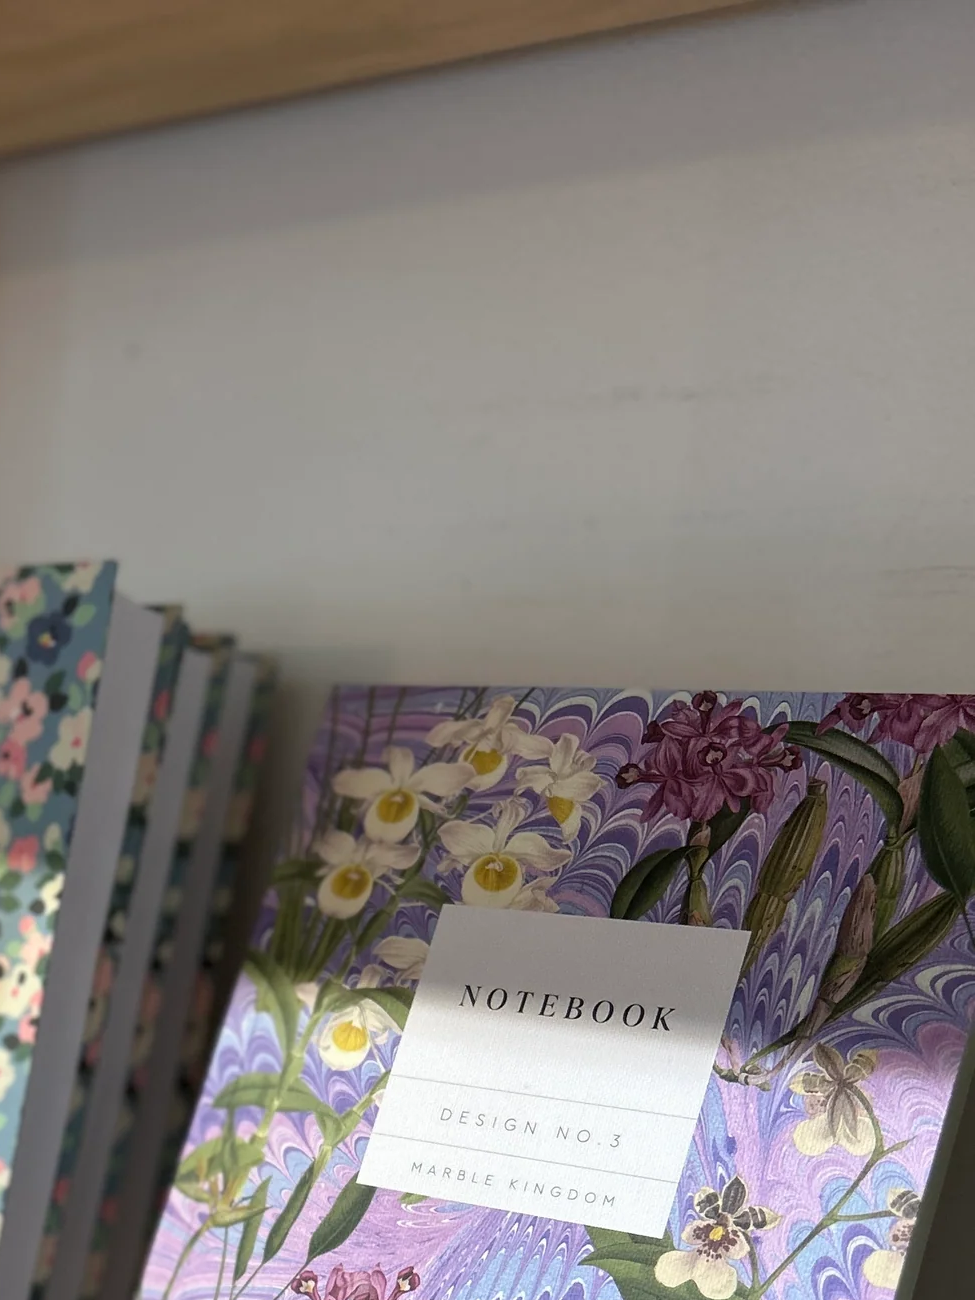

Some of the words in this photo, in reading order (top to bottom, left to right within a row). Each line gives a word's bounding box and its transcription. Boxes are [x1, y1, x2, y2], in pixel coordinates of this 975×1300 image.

[458, 984, 677, 1032] NOTEBOOK
[439, 1107, 538, 1136] DESIGN
[556, 1125, 623, 1149] NO.3
[411, 1161, 495, 1187] MARBLE
[508, 1177, 618, 1208] KINGDOM
